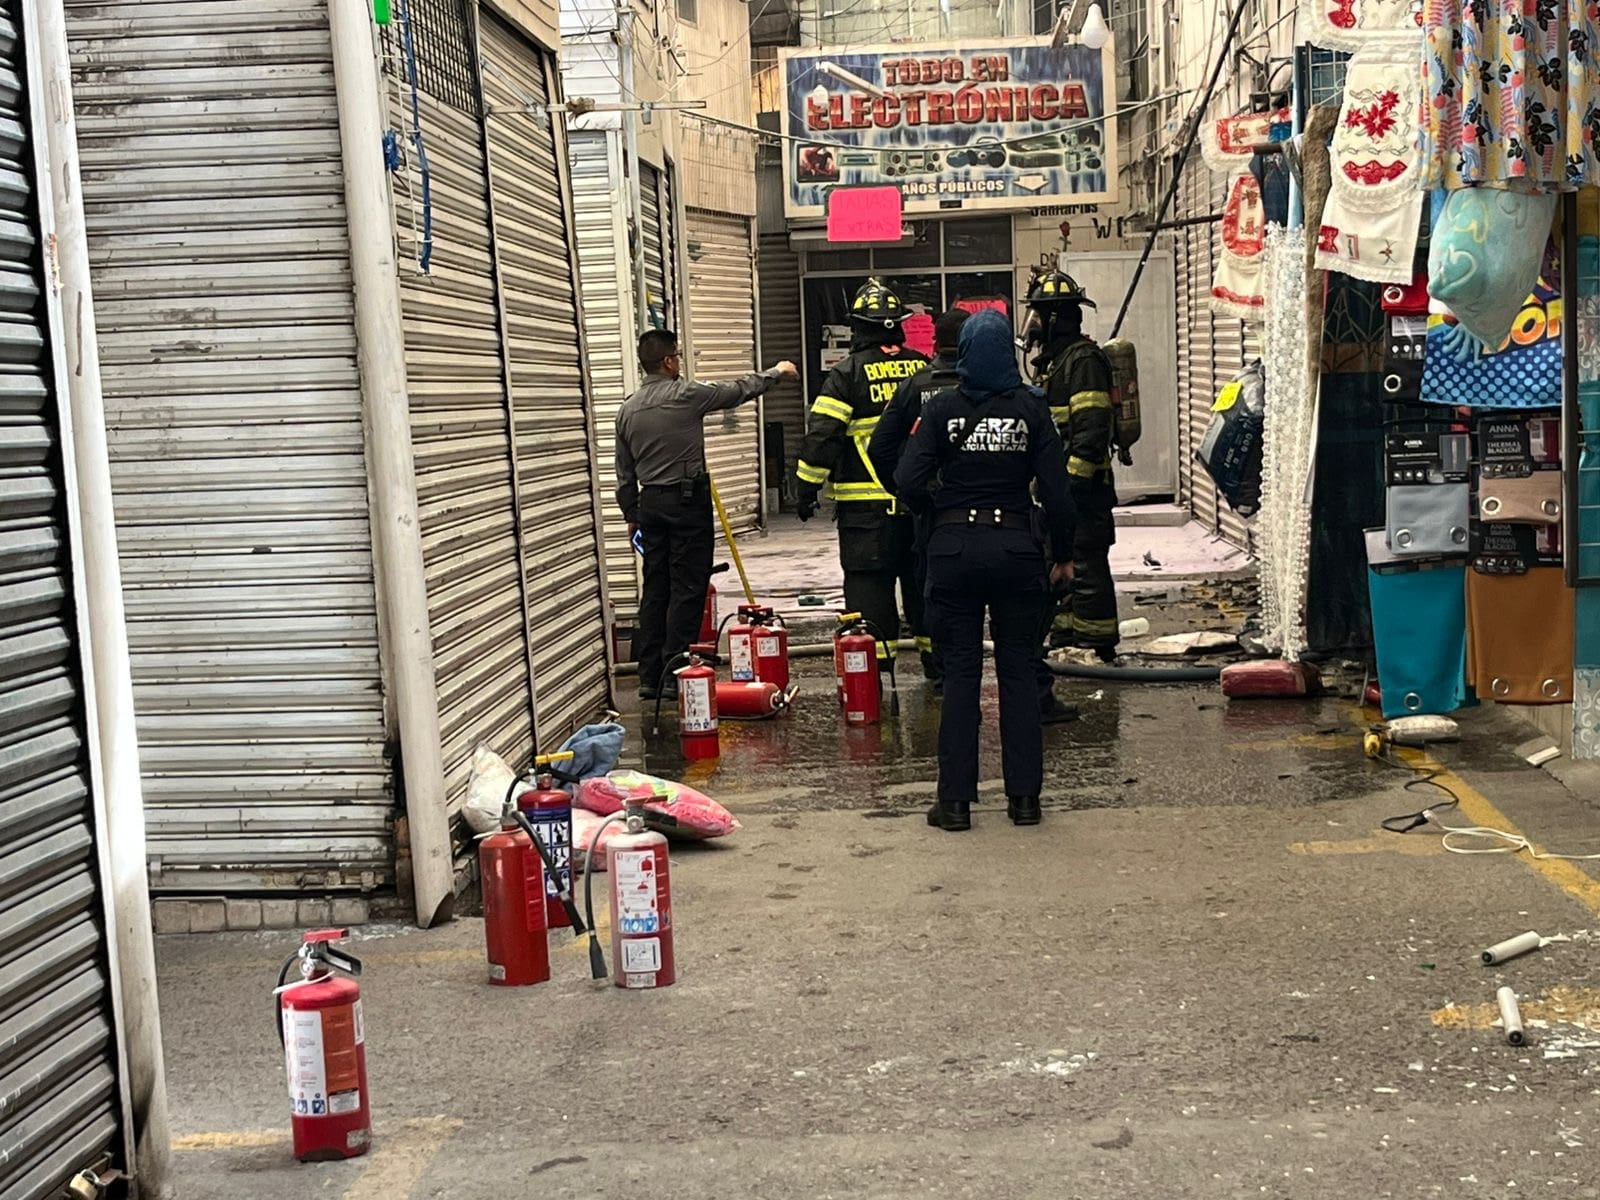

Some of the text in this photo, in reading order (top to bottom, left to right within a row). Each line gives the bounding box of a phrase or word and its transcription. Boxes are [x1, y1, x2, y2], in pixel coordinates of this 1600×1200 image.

[882, 56, 1009, 86] TODO EN
[807, 82, 1092, 131] ELECTRÓNICA
[901, 179, 1005, 195] AÑOS PÚBLICOS
[1488, 424, 1520, 434] ANNA
[948, 432, 1029, 444] CNTINELA
